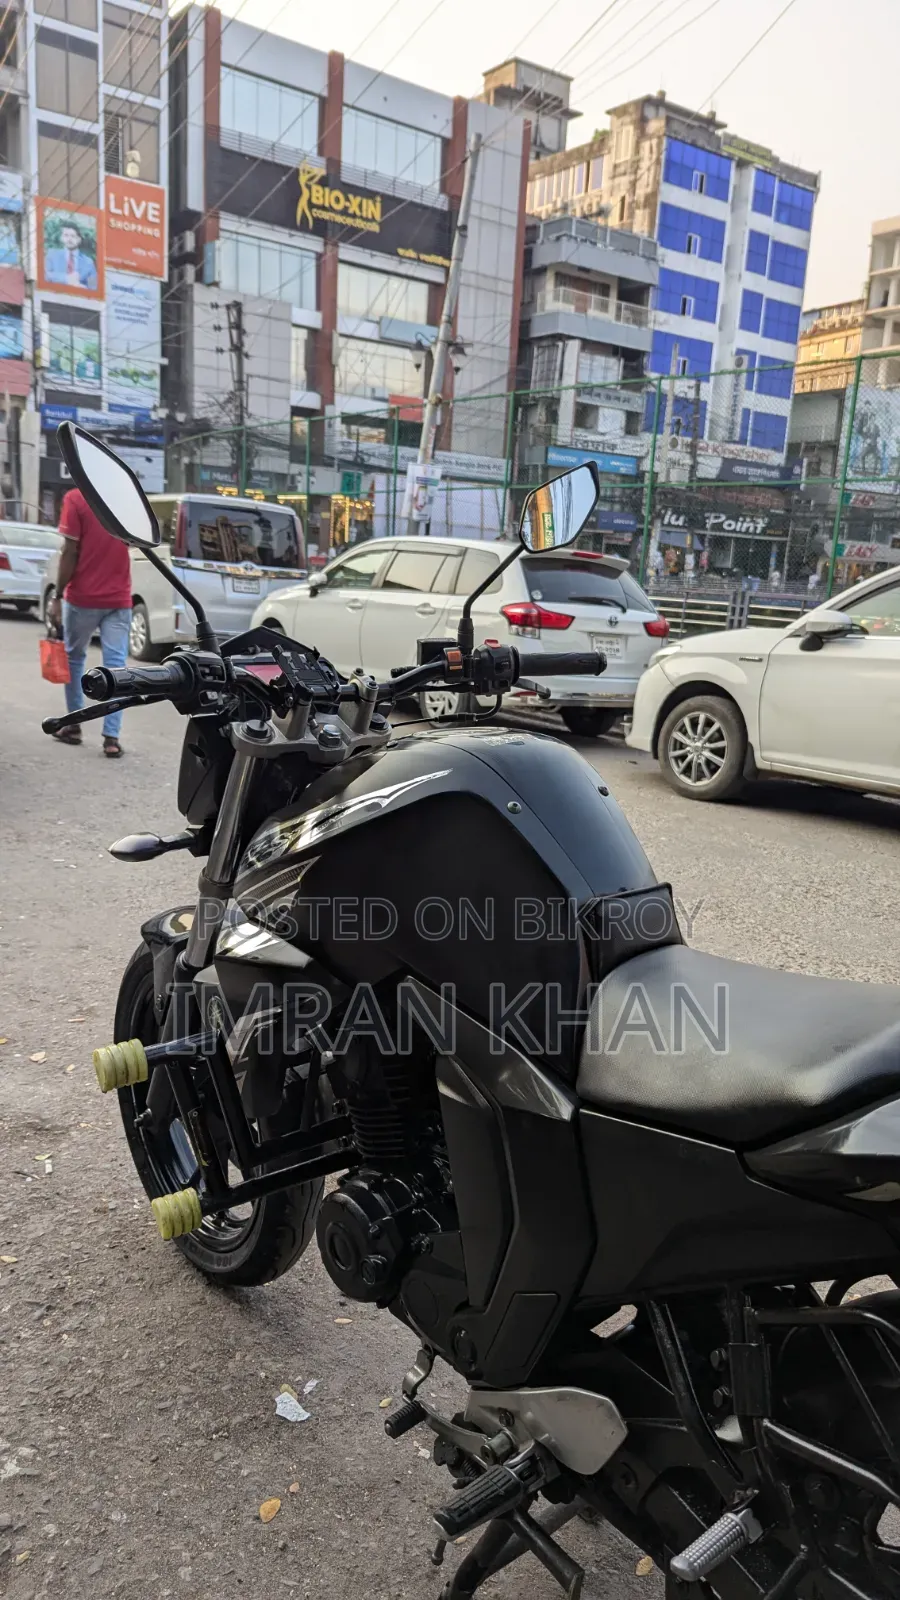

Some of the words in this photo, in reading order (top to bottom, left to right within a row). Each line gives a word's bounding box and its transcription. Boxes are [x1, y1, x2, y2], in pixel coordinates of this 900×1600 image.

[109, 192, 160, 223] LiVE
[311, 184, 382, 222] BIO-XIN
[109, 218, 160, 237] SHOPPING
[705, 512, 769, 534] Point
